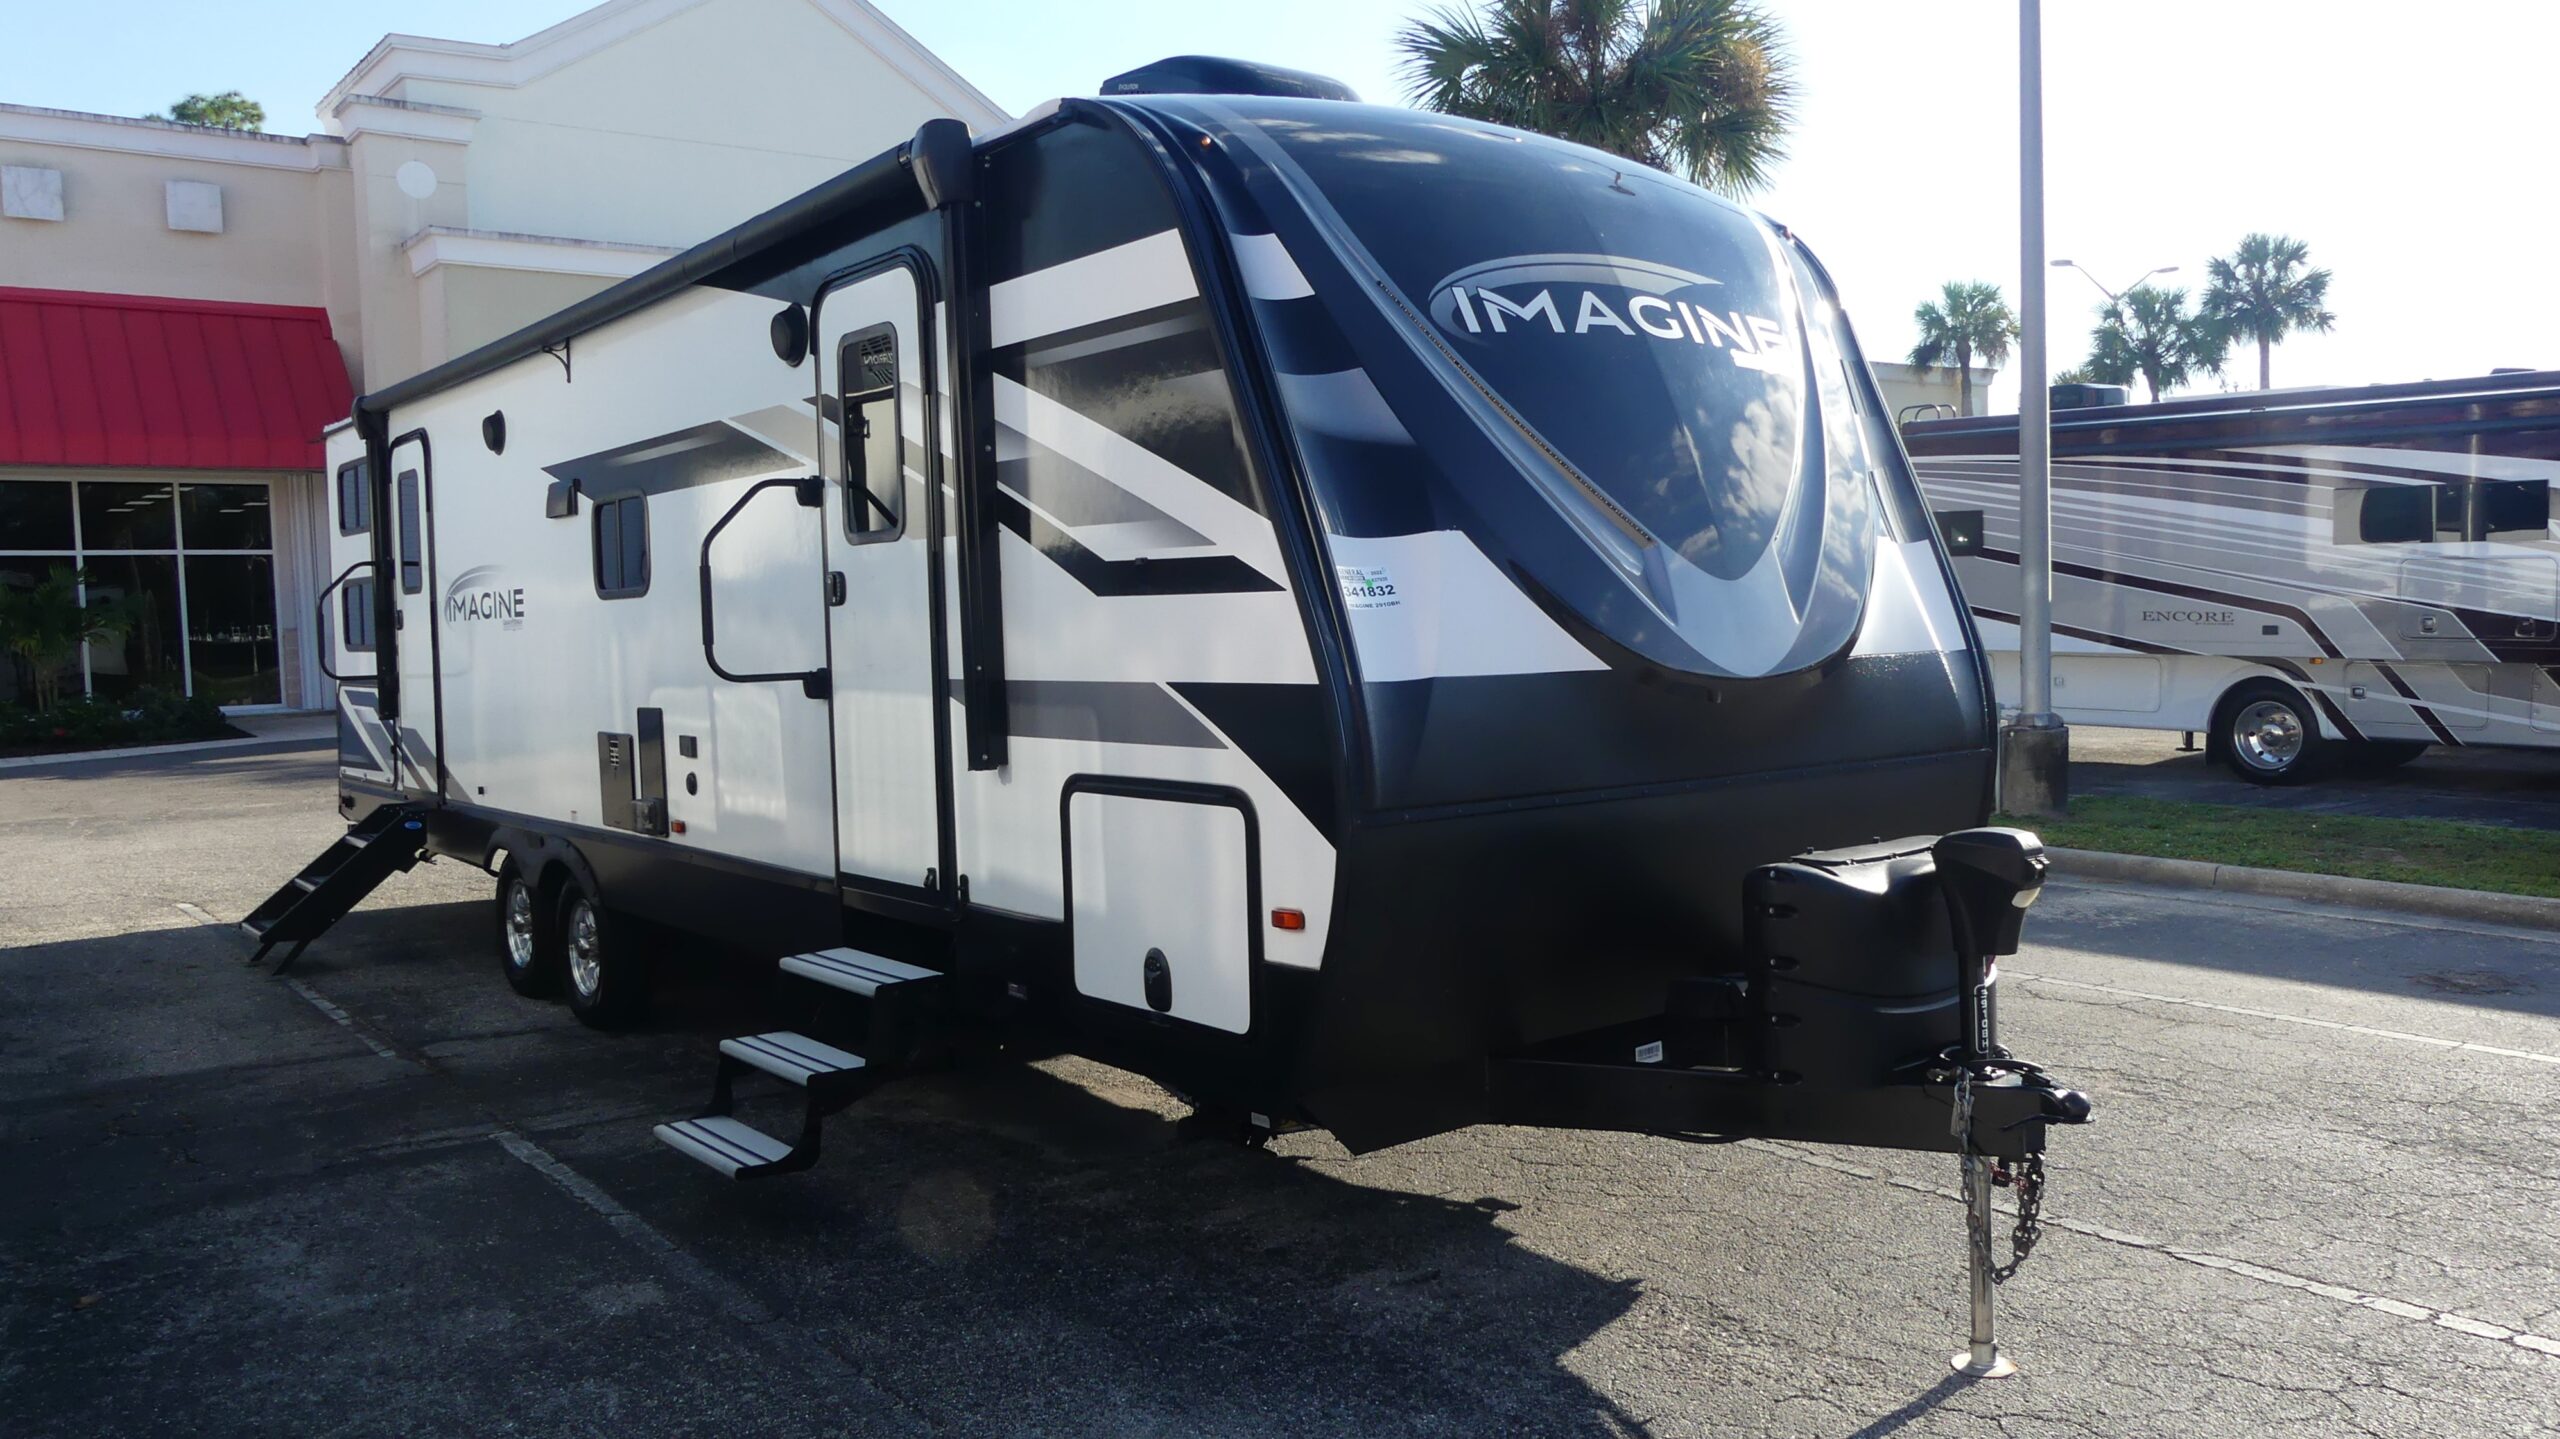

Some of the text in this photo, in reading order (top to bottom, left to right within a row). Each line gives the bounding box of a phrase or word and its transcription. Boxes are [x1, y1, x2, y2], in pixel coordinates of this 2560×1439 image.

[1452, 286, 1786, 359] IMAGINE
[1344, 585, 1396, 597] 341832
[448, 588, 525, 622] IMAGINE
[2142, 611, 2235, 622] ENCORE
